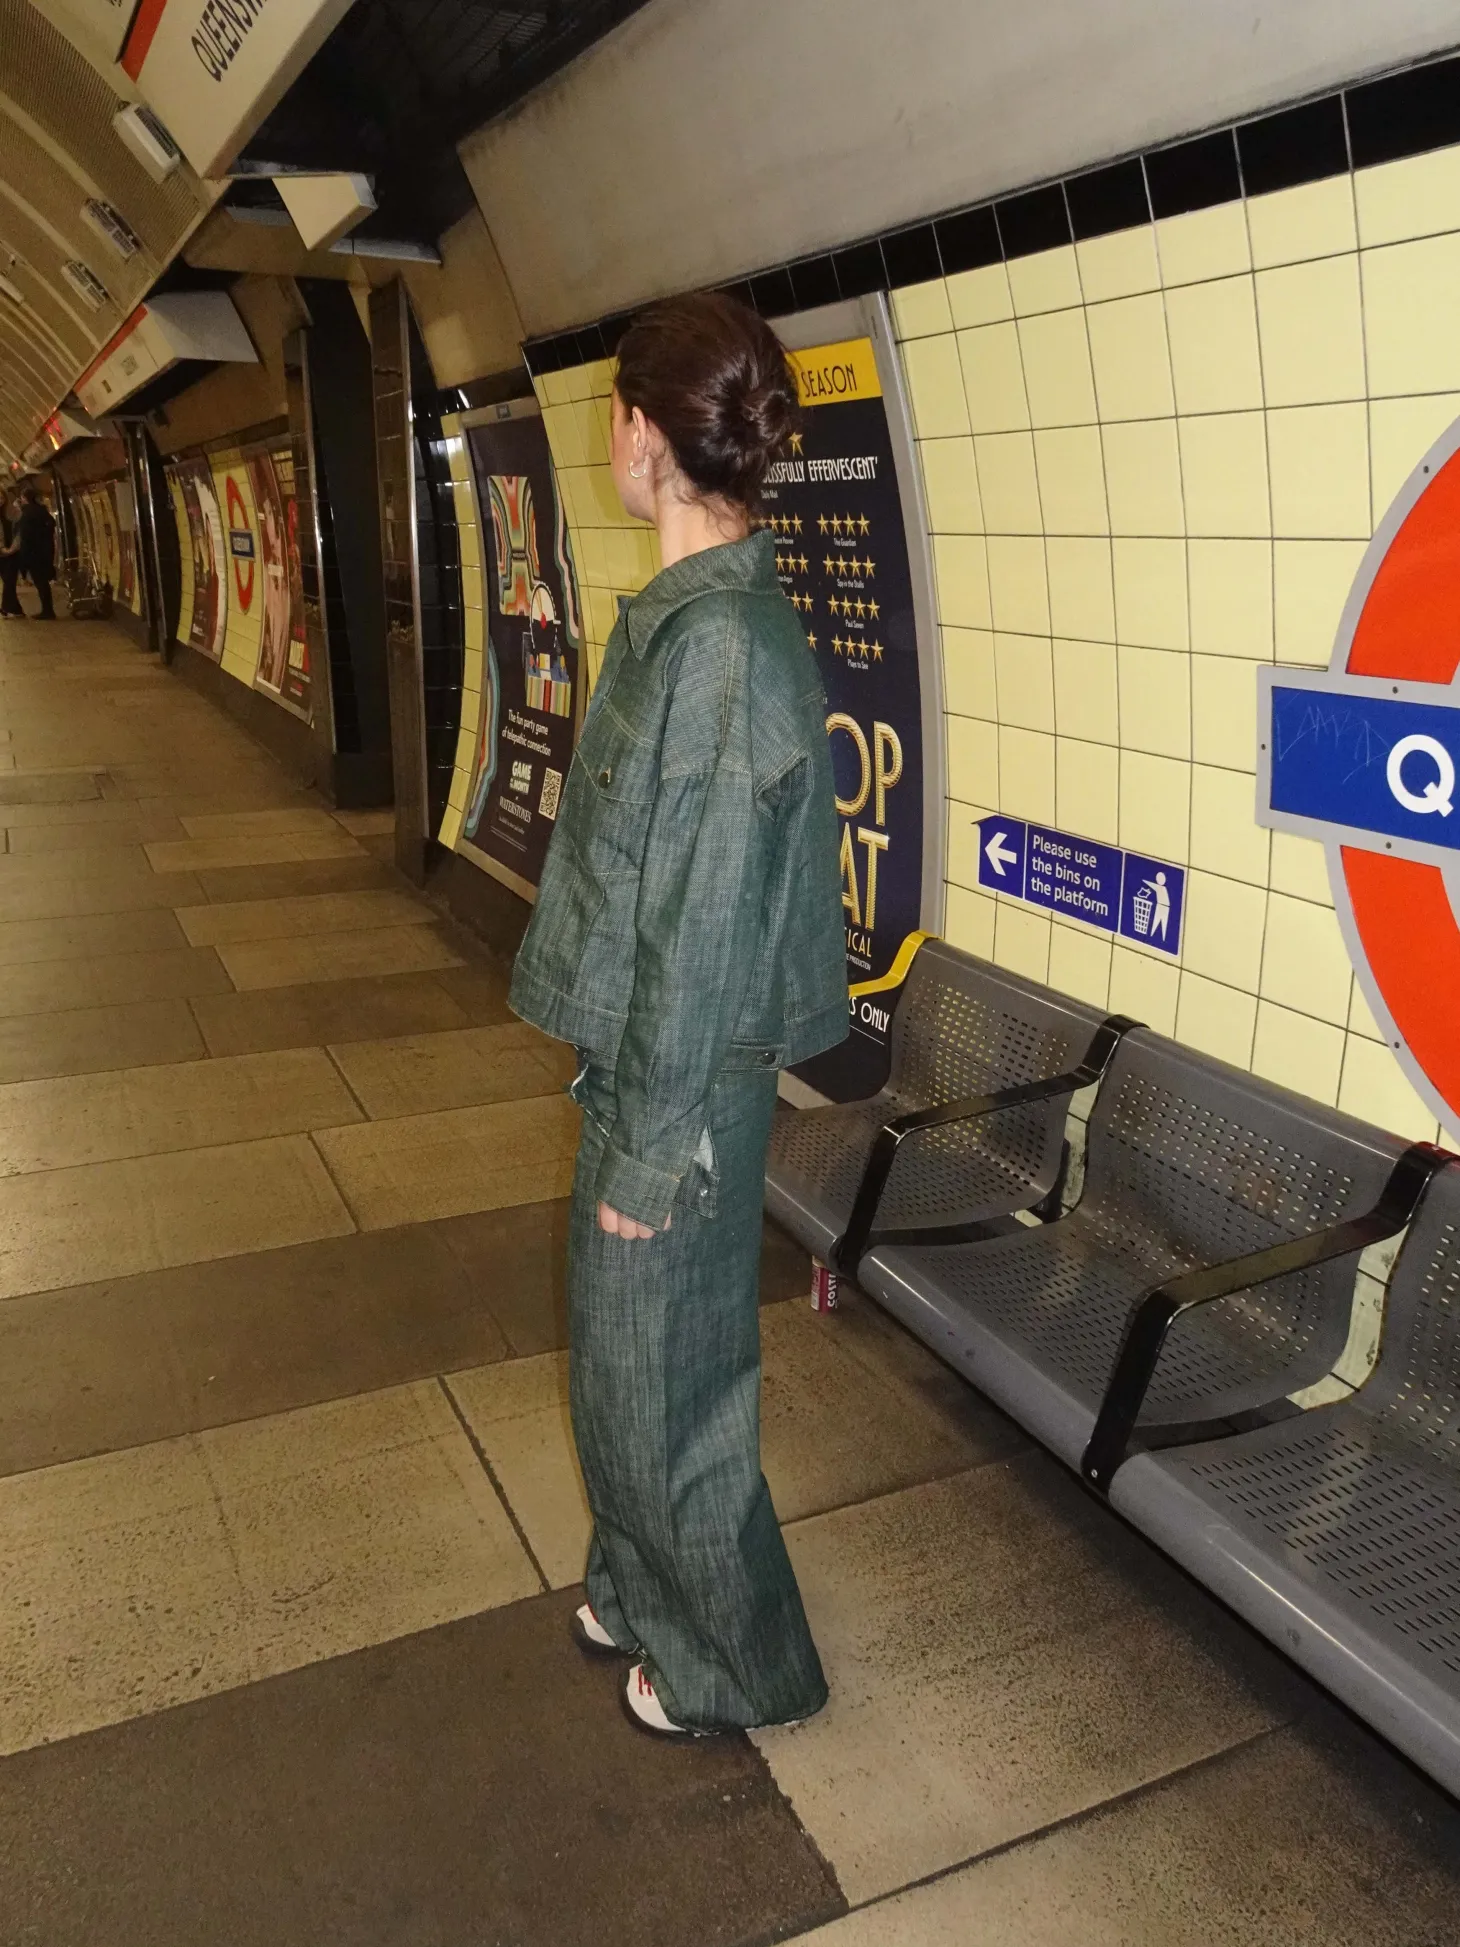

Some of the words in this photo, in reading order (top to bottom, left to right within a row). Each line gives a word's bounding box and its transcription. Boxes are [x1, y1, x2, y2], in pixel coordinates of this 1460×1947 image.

[801, 363, 858, 398] SEASON
[763, 460, 805, 484] LISSFULLY
[840, 537, 857, 547] Guardian
[508, 709, 516, 723] The
[523, 719, 536, 734] party
[535, 723, 549, 736] game
[501, 725, 508, 738] of
[507, 727, 527, 747] telepathic
[526, 740, 552, 757] connection
[512, 760, 532, 780] GAME
[825, 712, 903, 827] OP
[1032, 834, 1071, 861] Please
[1074, 851, 1097, 868] use
[839, 821, 889, 932] AT
[1031, 856, 1052, 876] the
[1055, 864, 1081, 885] bins
[1083, 877, 1100, 892] on
[1030, 876, 1051, 896] the
[1054, 886, 1109, 916] platform
[846, 928, 872, 958] ICAL
[849, 954, 872, 971] PRODUCTION
[861, 1002, 890, 1033] ONLY
